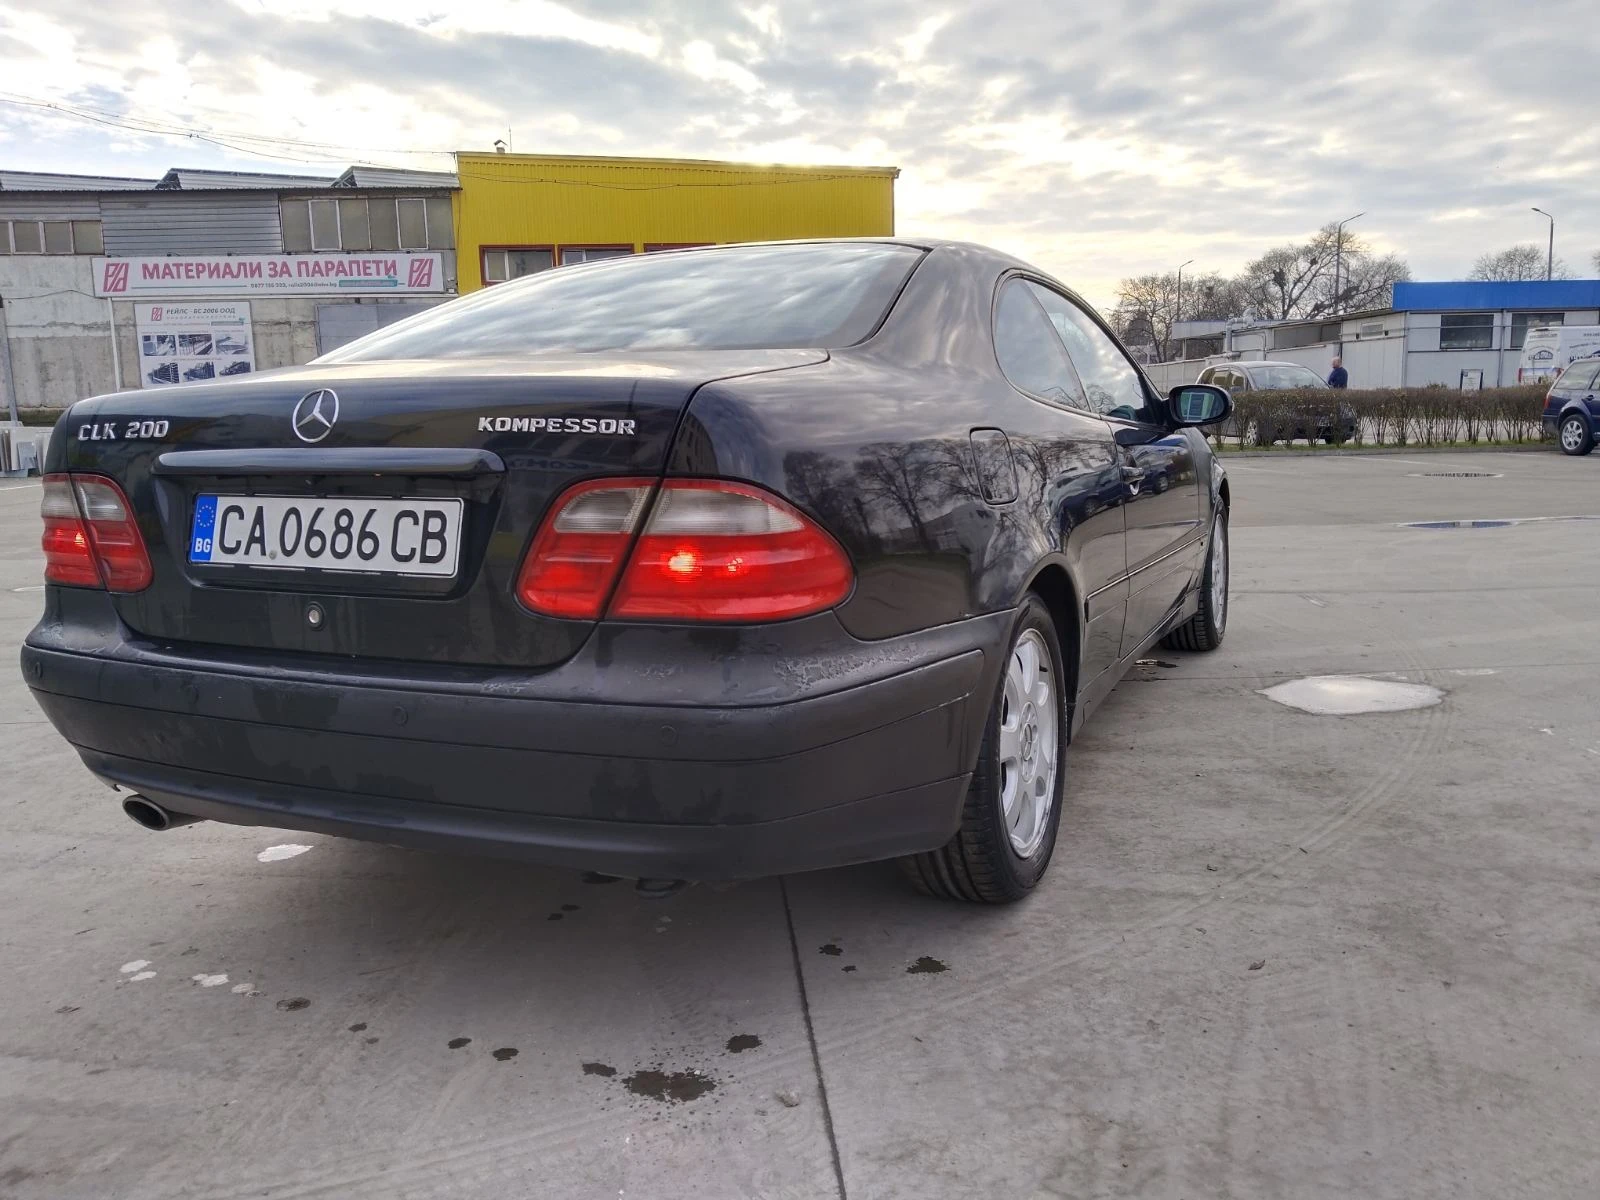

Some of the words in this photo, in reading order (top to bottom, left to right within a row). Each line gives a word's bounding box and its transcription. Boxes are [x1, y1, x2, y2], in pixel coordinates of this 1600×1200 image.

[141, 261, 263, 280] МАТЕРИАЛИ
[267, 260, 293, 279] ЗА
[296, 258, 398, 279] ПАРАПЕТИ
[78, 422, 118, 442] CLK
[125, 420, 169, 439] 200
[477, 417, 636, 436] KOMPESSOR
[194, 537, 211, 553] BG
